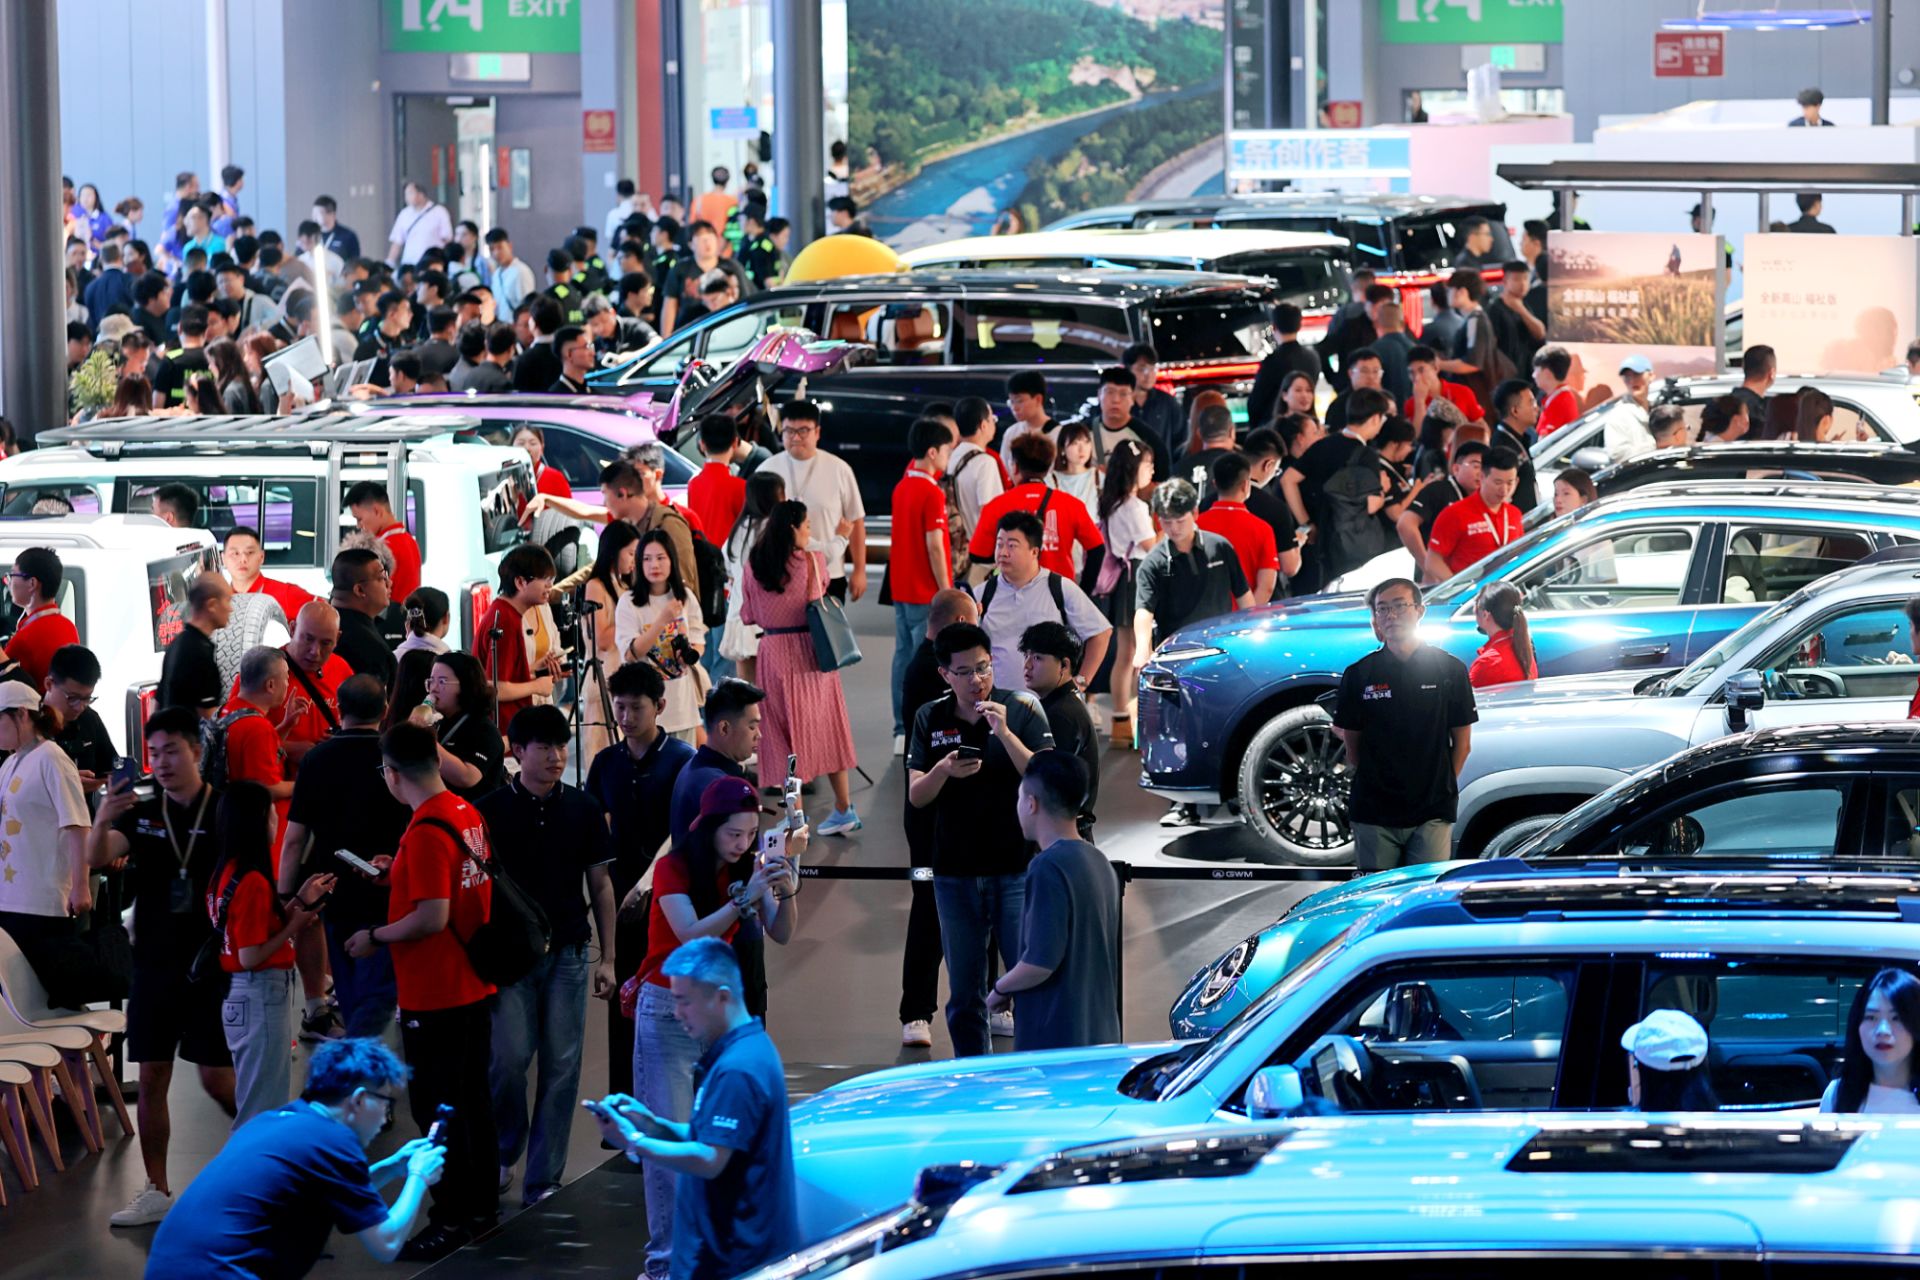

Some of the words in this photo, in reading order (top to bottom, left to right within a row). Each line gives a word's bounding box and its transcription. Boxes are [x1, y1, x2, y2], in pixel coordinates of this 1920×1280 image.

[508, 0, 570, 17] EXIT
[799, 868, 819, 877] WM
[1225, 870, 1254, 879] GWM
